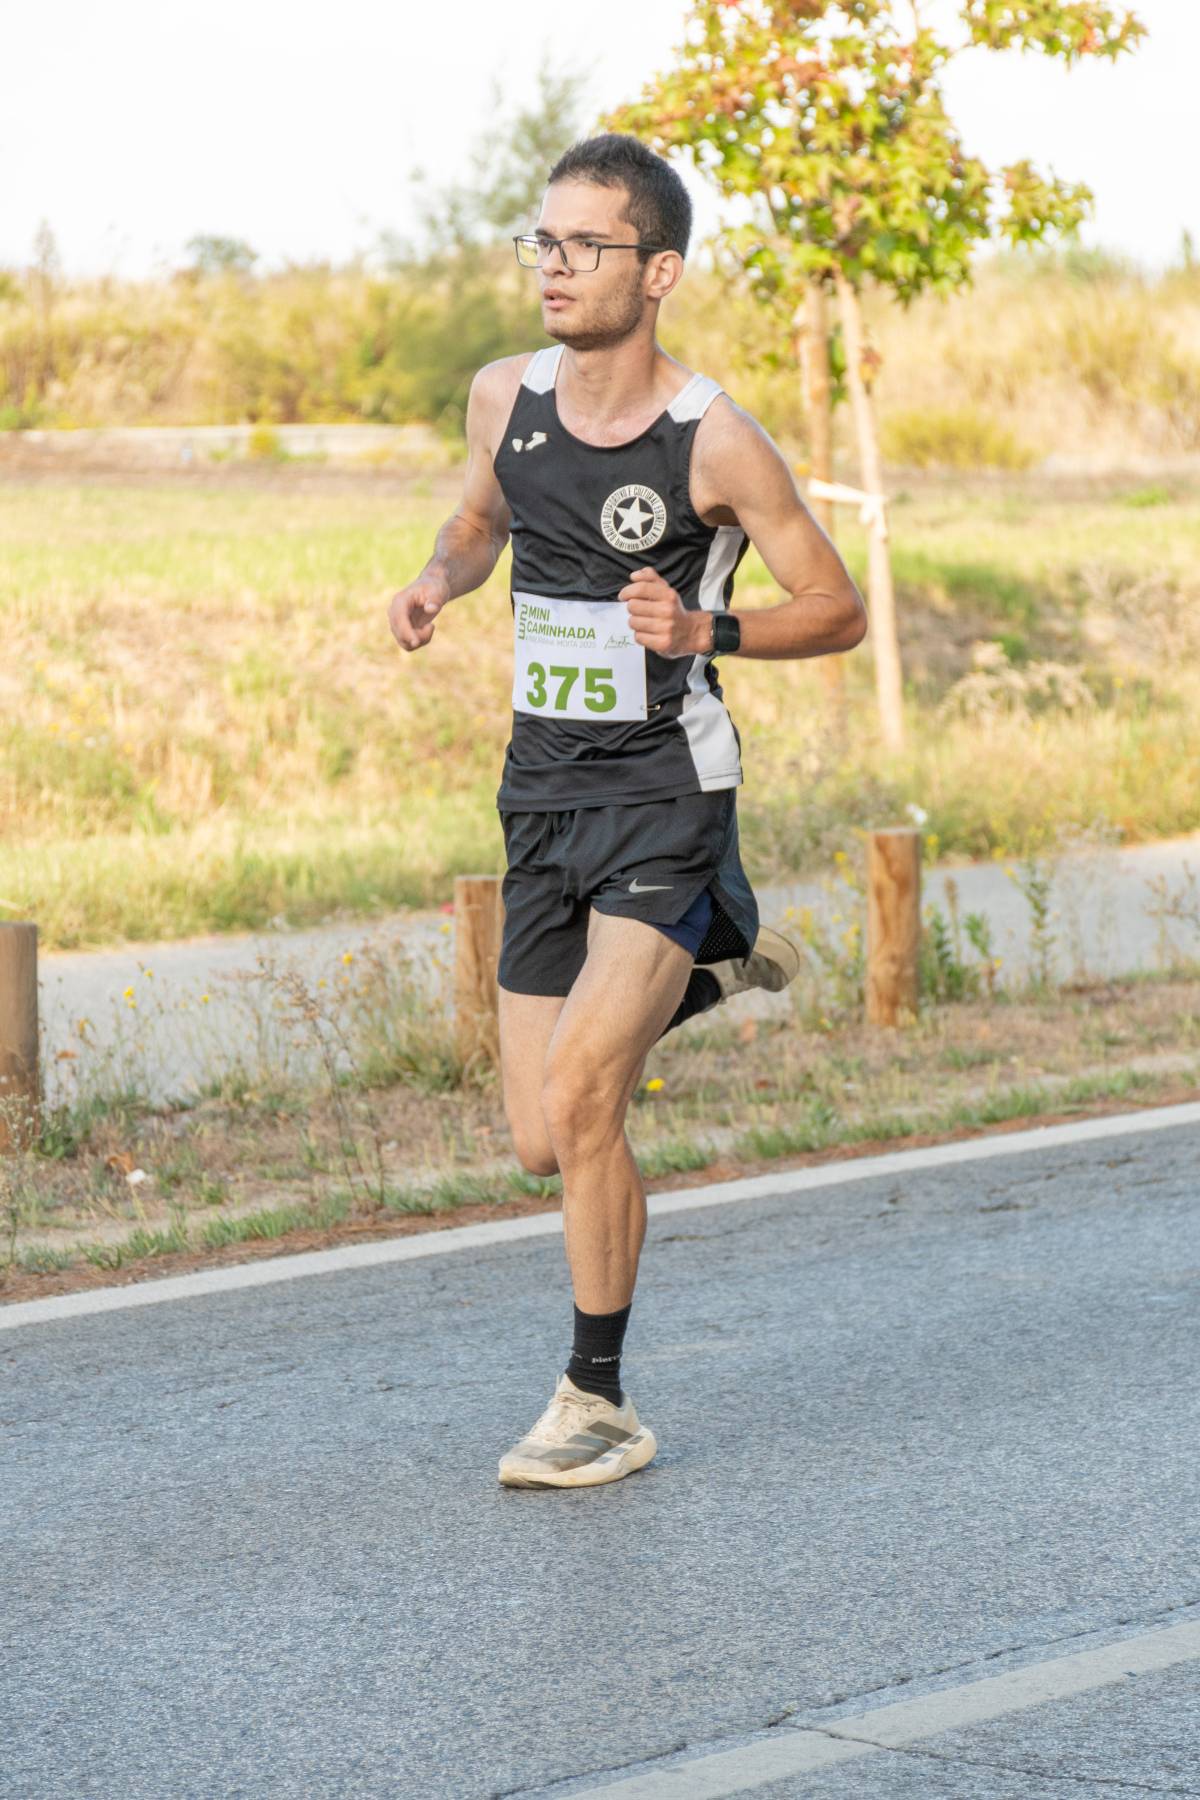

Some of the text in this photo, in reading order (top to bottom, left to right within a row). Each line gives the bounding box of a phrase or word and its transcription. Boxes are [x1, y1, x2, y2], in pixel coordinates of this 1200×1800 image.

[529, 605, 550, 622] MINI
[527, 620, 596, 639] CAMINHADA
[526, 661, 617, 713] 375
